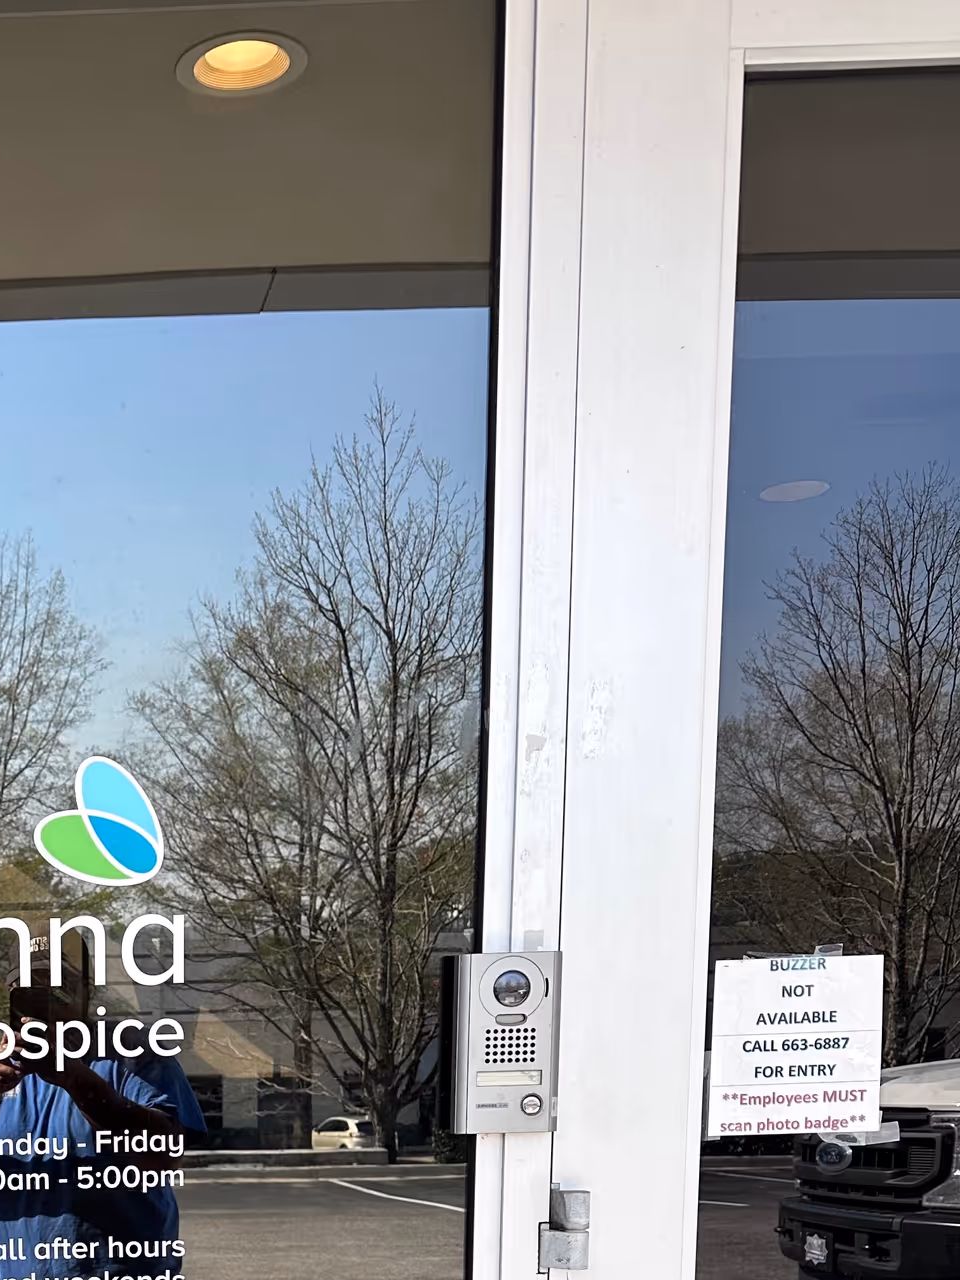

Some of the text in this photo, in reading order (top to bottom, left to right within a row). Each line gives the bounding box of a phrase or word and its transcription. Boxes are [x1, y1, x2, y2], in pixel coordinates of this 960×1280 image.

[769, 957, 827, 972] BUZZER
[781, 984, 815, 998] NOT
[755, 1010, 838, 1026] AVAILABLE
[742, 1037, 850, 1053] CALL 663-6887
[754, 1063, 837, 1079] FOR ENTRY
[822, 1089, 867, 1103] MUST
[720, 1121, 752, 1133] scan
[756, 1117, 800, 1134] photo
[96, 1129, 184, 1158] Friday
[77, 1165, 184, 1193] 5:00pm
[34, 1237, 100, 1260] after
[108, 1236, 186, 1258] hours
